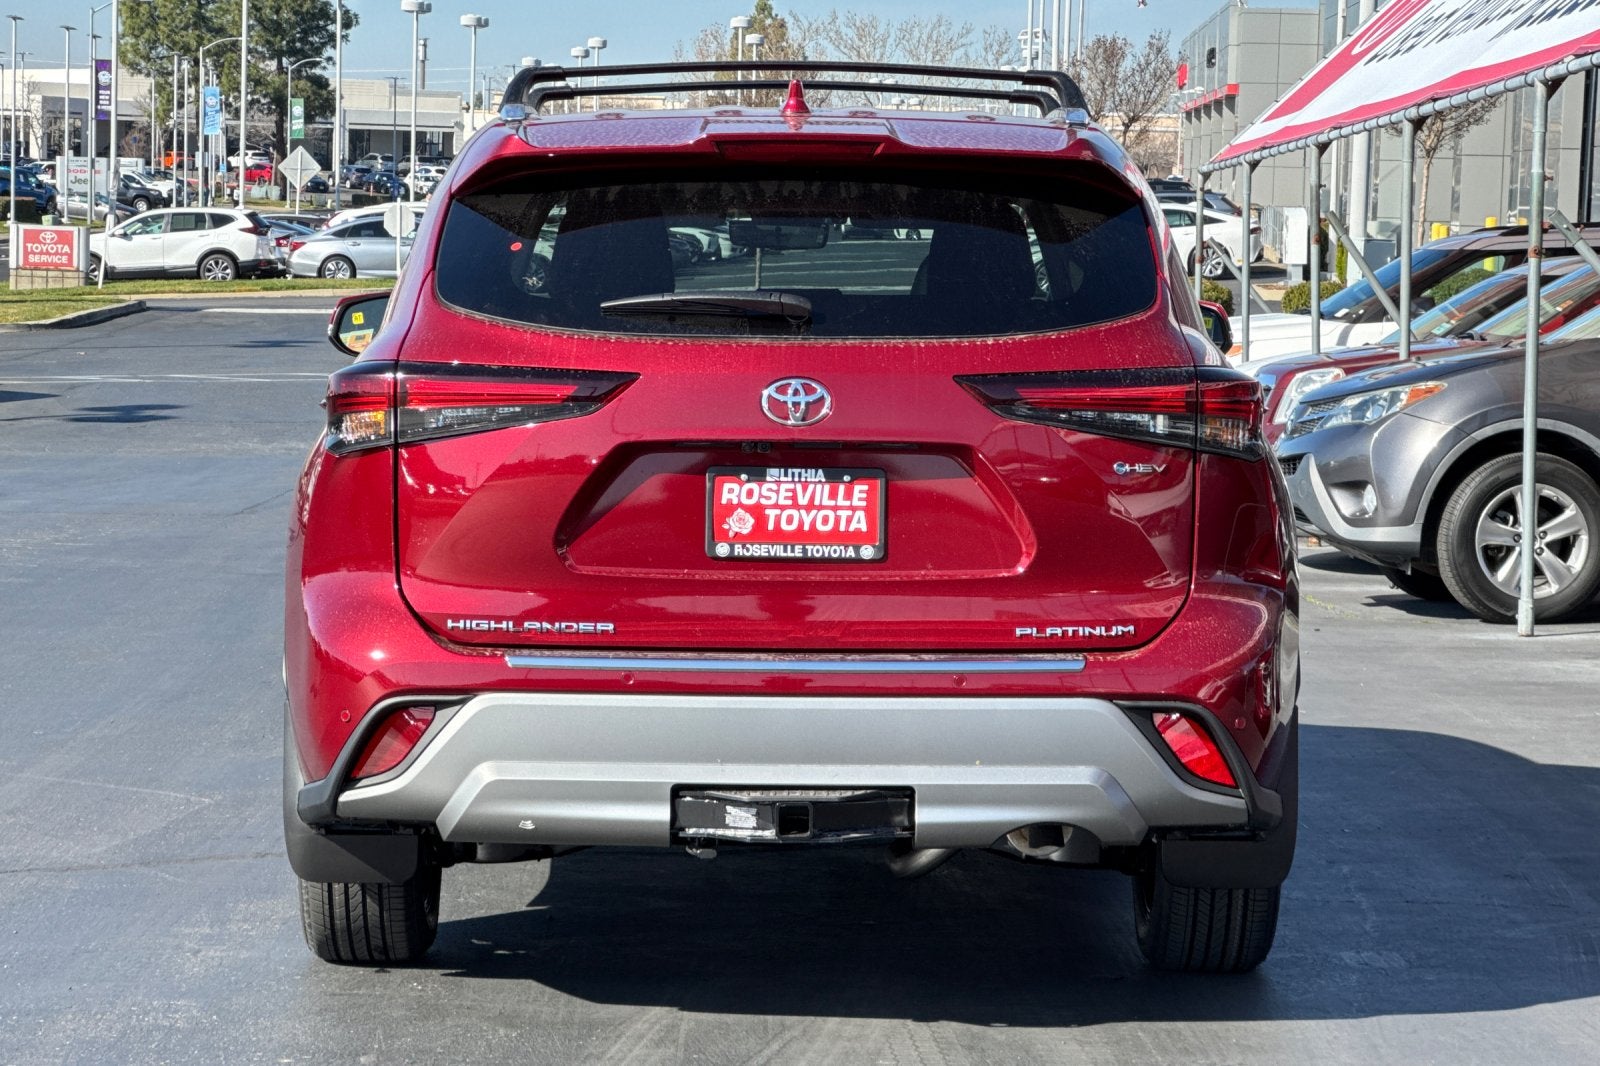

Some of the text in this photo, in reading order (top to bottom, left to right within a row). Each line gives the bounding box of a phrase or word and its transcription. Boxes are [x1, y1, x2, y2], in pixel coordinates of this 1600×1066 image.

[70, 175, 89, 185] Jee
[25, 243, 71, 253] TOYOTA
[28, 254, 68, 264] SERVICE
[780, 468, 826, 482] LITHIA
[720, 482, 869, 507] ROSEVILLE
[764, 508, 868, 532] TOYOTA
[734, 544, 856, 558] ROSEVILLE TOYOTA
[447, 619, 615, 634] HIGHLANDER
[1015, 625, 1135, 637] PLATINUM
